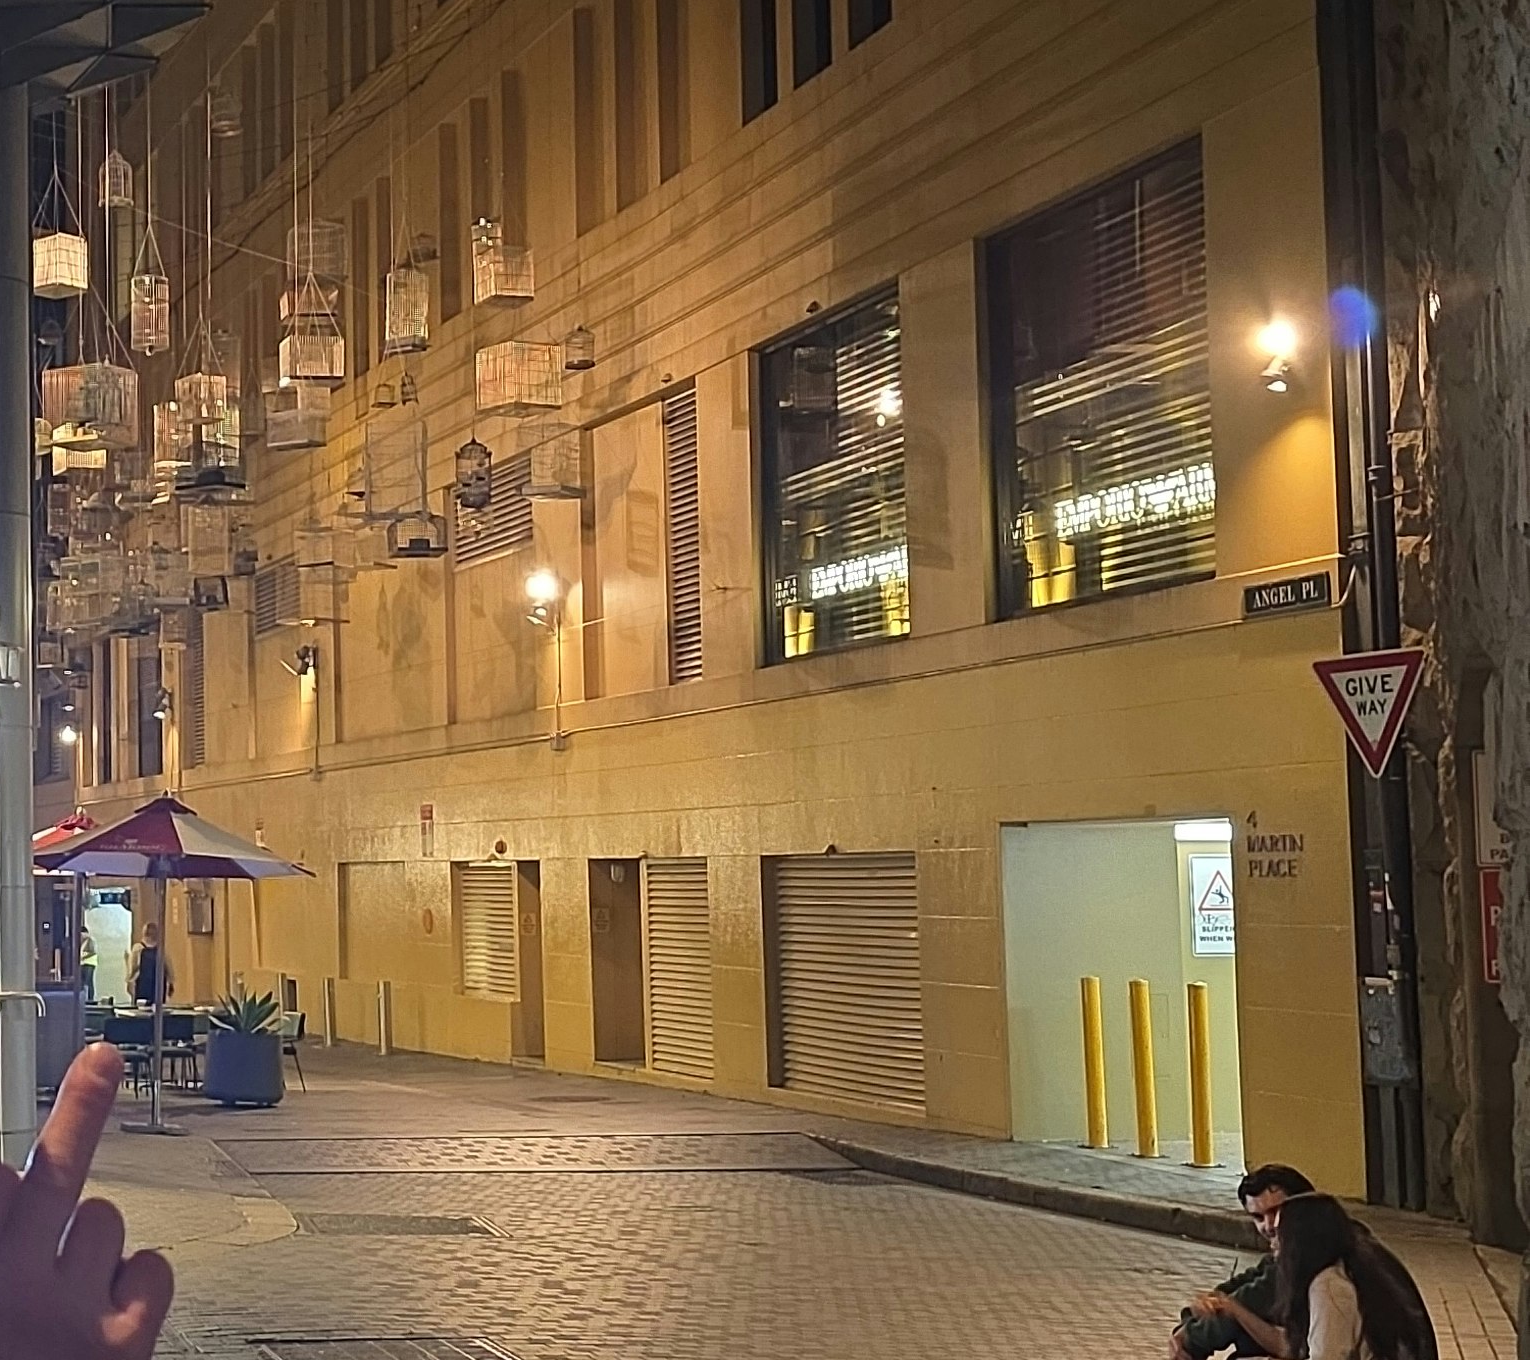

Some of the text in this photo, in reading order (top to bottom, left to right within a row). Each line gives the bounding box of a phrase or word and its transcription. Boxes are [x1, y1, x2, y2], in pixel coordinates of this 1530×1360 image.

[1253, 580, 1319, 608] ANGEL PL
[1345, 674, 1394, 696] GIVE
[1356, 698, 1387, 717] WAY
[1246, 809, 1258, 828] 4
[1246, 833, 1304, 853] MARTIN
[1248, 858, 1298, 878] PLACE
